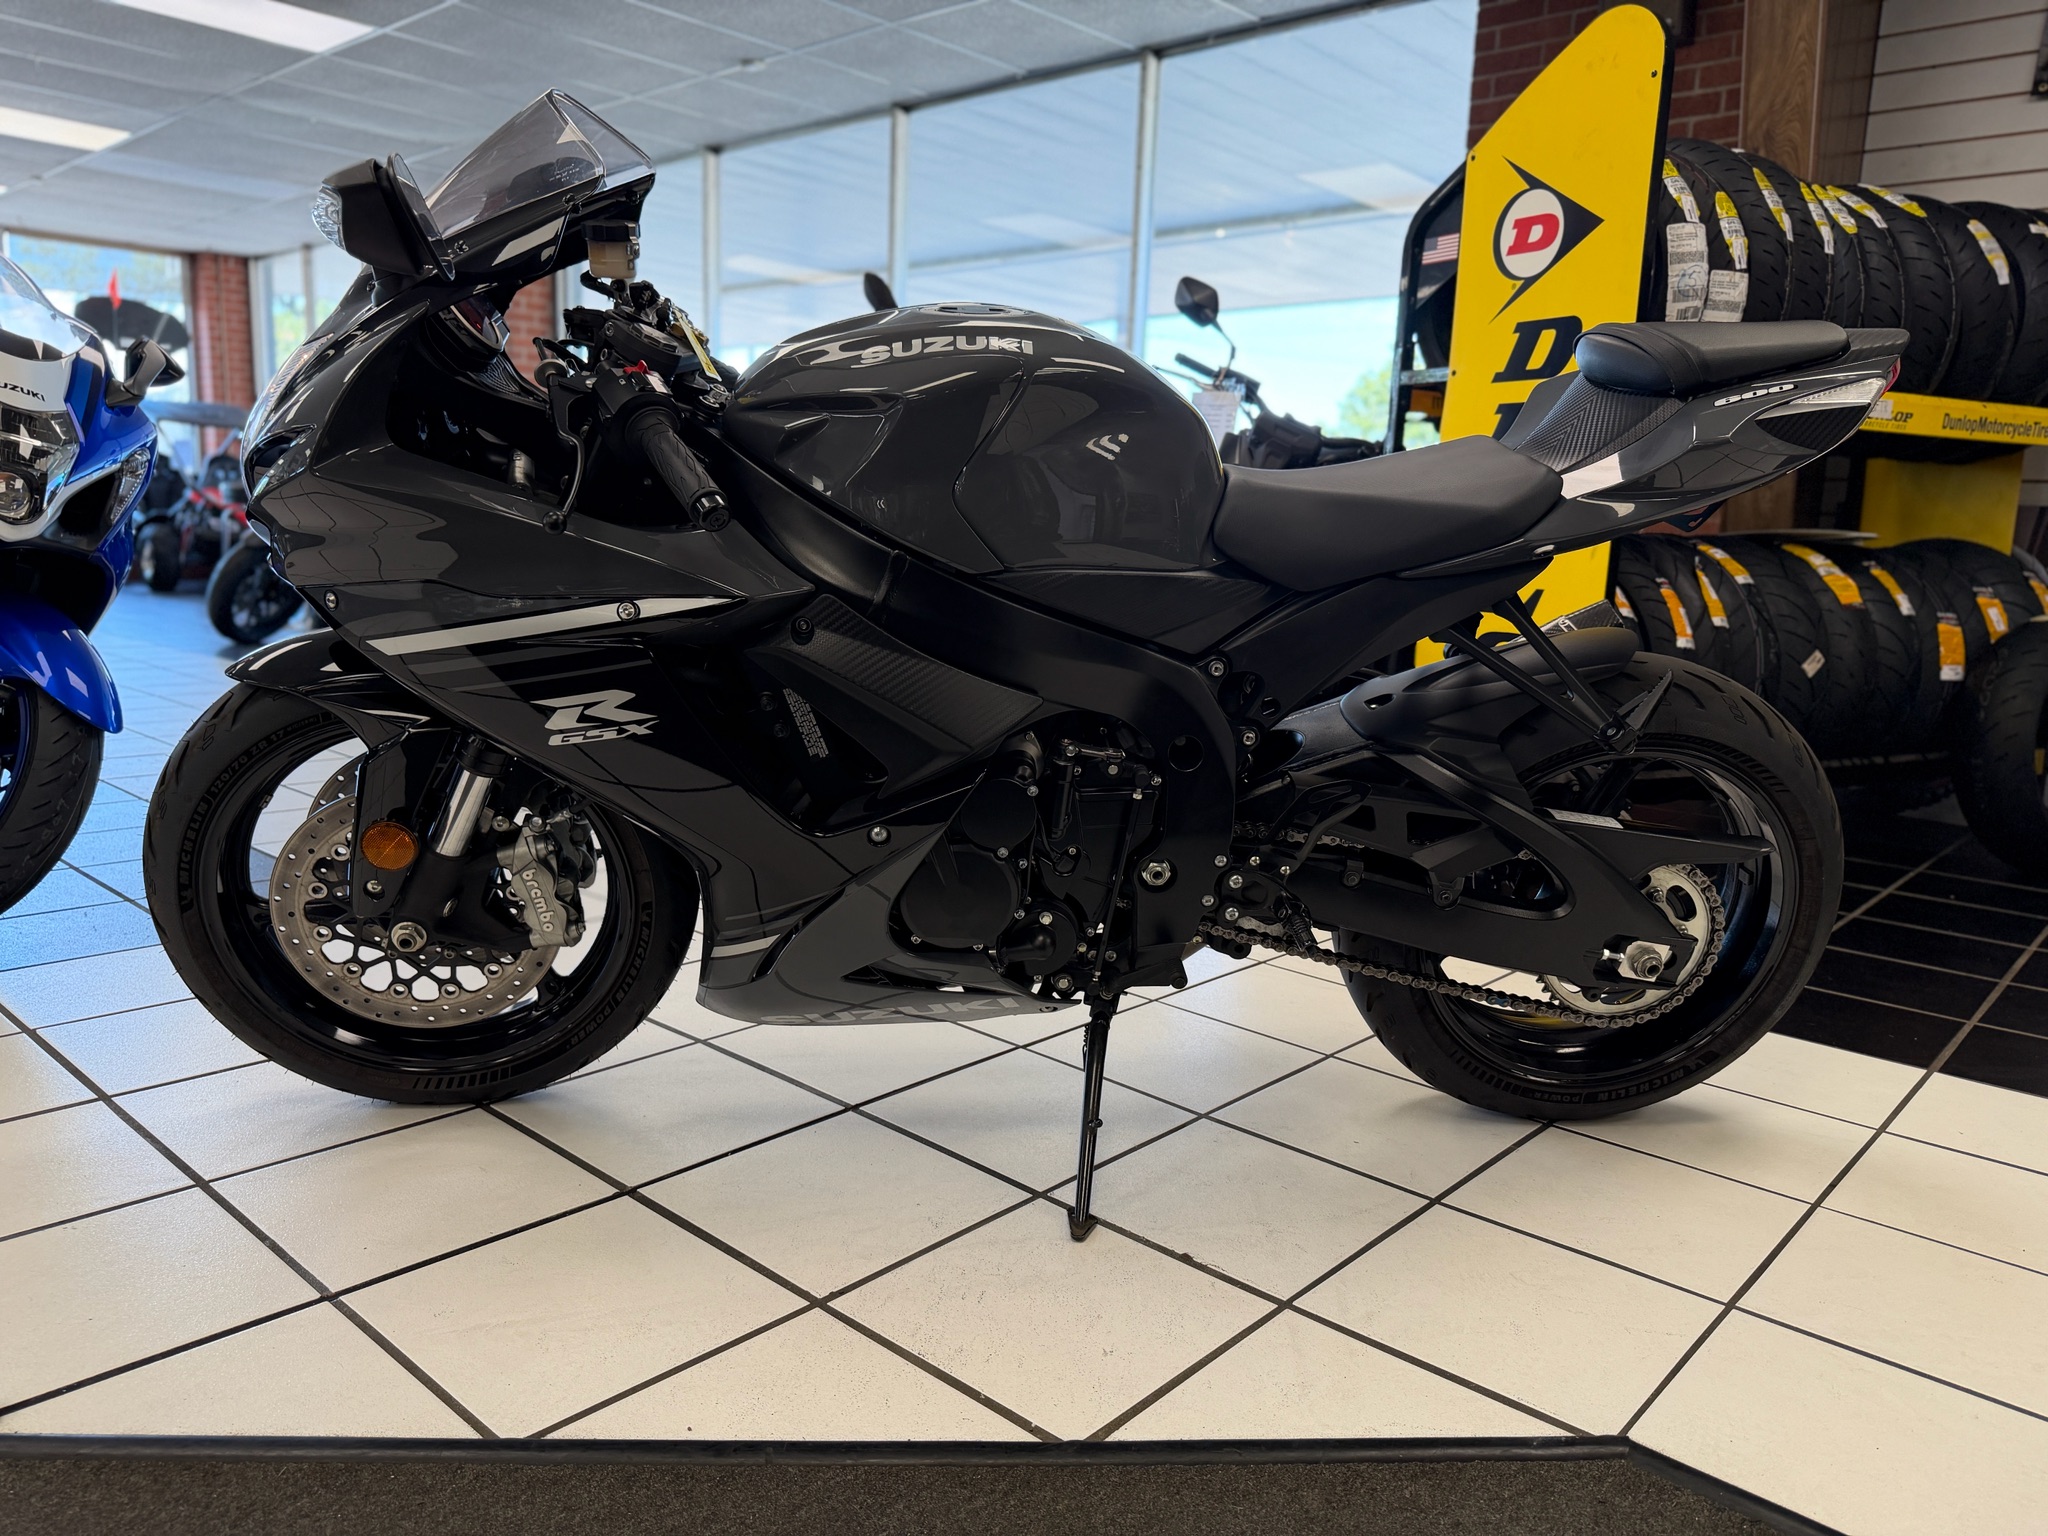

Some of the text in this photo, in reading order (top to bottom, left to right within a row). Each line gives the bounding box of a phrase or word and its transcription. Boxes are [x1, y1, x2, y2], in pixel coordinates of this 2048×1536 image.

[1505, 213, 1560, 257] D
[860, 335, 1034, 364] SUZUKI
[0, 382, 46, 402] UZUKI
[530, 689, 658, 731] R
[210, 754, 248, 799] 120/70
[250, 739, 269, 757] ZR
[270, 730, 286, 745] 17
[178, 799, 211, 885] MICHELIN
[522, 867, 555, 932] brembo
[570, 921, 653, 1048] MICHELIN POWER
[760, 997, 1020, 1026] SUZUKI
[1532, 1067, 1685, 1104] MICHELIN POWER
